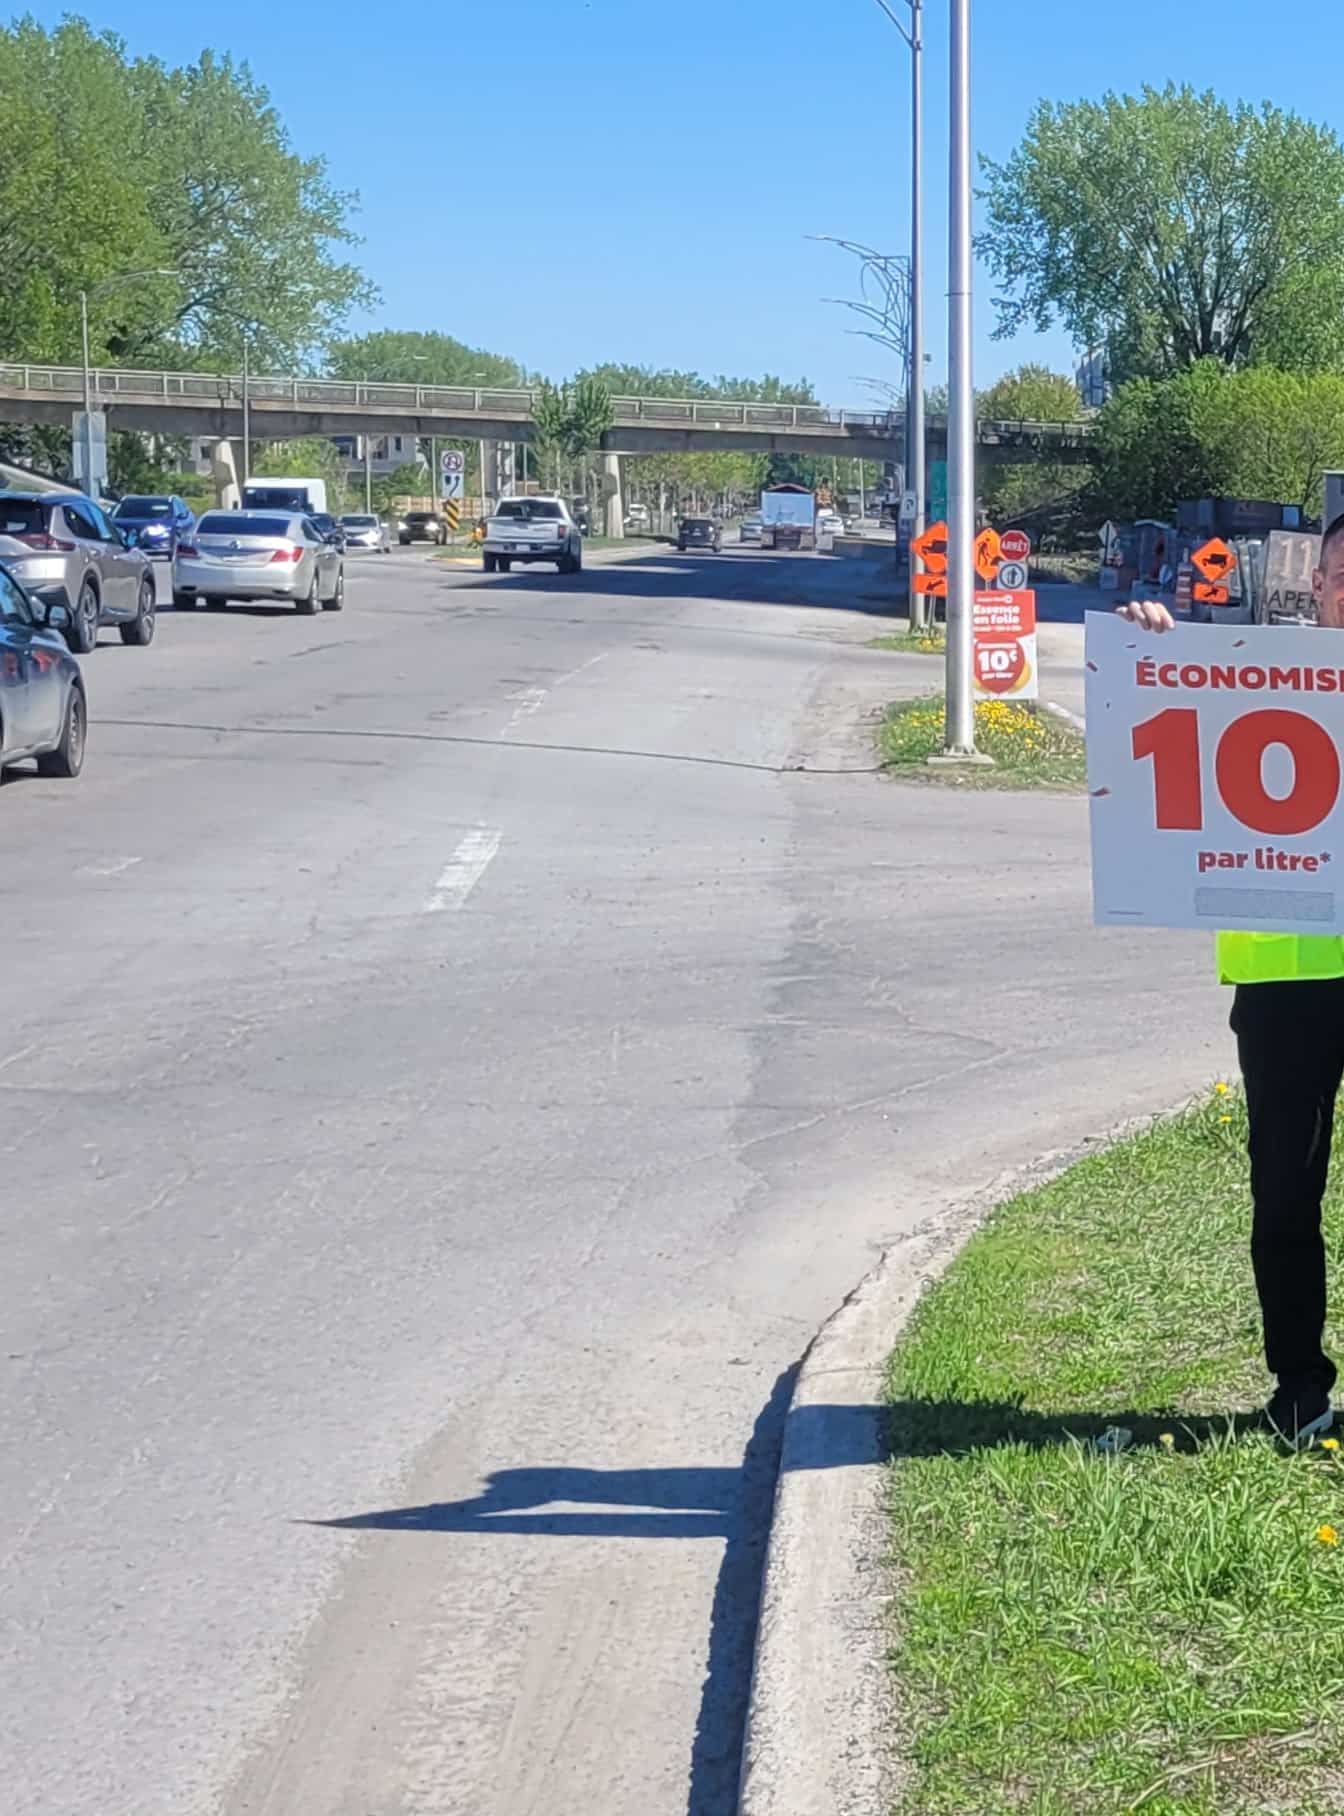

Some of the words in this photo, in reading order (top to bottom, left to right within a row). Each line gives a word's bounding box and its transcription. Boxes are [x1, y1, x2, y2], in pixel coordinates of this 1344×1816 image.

[1001, 539, 1028, 553] ARRÊT
[973, 604, 1020, 615] Essence
[991, 614, 1020, 625] folie
[1198, 848, 1249, 873] par
